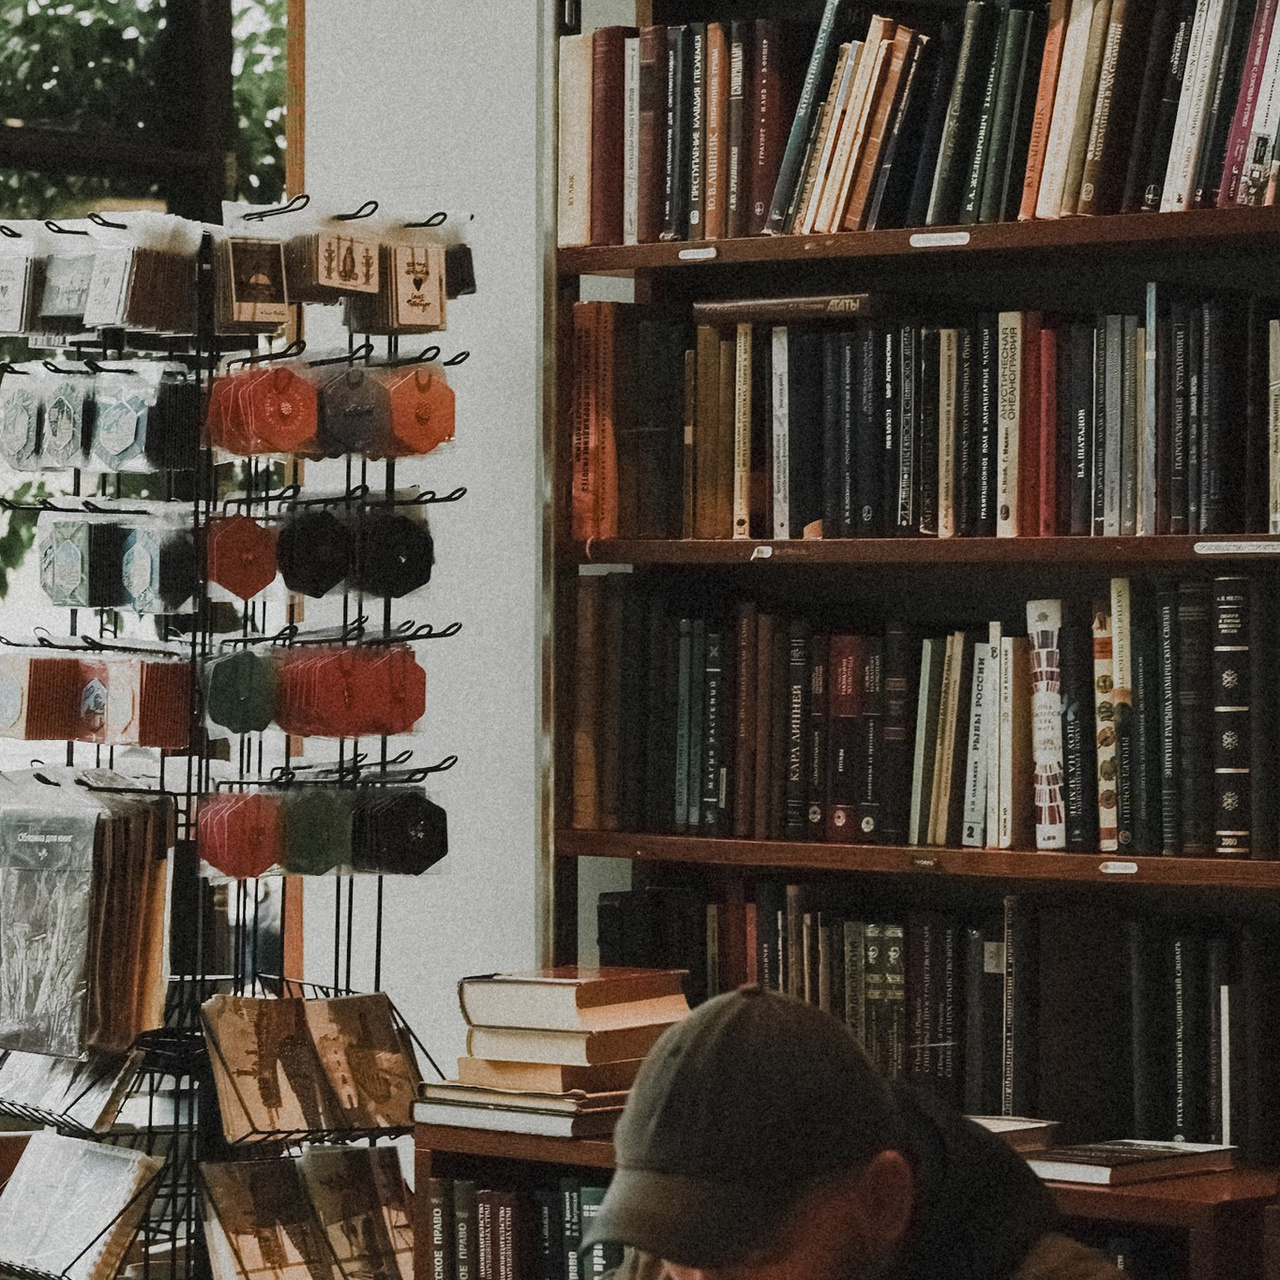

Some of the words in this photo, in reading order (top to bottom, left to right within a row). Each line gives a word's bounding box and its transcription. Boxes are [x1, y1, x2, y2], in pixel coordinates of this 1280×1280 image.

[693, 35, 701, 83] ПТОЛЕМЕЯ
[796, 52, 820, 116] МАТЕМАТИКА
[692, 87, 701, 128] КЛАВДИЯ
[691, 131, 700, 200] ПРЕСТУПЛЕНИЕ
[970, 114, 988, 187] ЖЕЛНОРОВИЧ
[826, 299, 859, 311] АГАТЫ
[1175, 330, 1184, 390] УСТАНОВКИ
[981, 368, 989, 423] ЭЛЕМЕНТАРНЫЕ
[1174, 397, 1183, 469] ПАРОГАЗОВЫЕ
[980, 457, 988, 518] ГРАВИТАЦИОННОЕ
[974, 657, 985, 706] РОССИИ
[708, 680, 716, 742] РАСТЕНИЙ
[791, 684, 801, 742] ЛИННЕЙ
[972, 713, 981, 750] РЫБЫ
[1066, 722, 1074, 748] ШОУ
[1121, 736, 1129, 776] РИЧАРД
[790, 746, 799, 781] КАРЛ
[1067, 755, 1075, 772] НА
[1068, 776, 1077, 817] ЗЕМЛЕ
[1122, 778, 1130, 823] ДОКИНЗ
[18, 832, 45, 843] Обложка
[45, 834, 58, 843] для
[58, 834, 73, 843] книг
[966, 825, 975, 839] 2
[1175, 1040, 1183, 1126] РУССКО-АНГЛИЙСКИЙ
[433, 1208, 442, 1243] ПРАВО
[458, 1222, 467, 1258] ПРАВО
